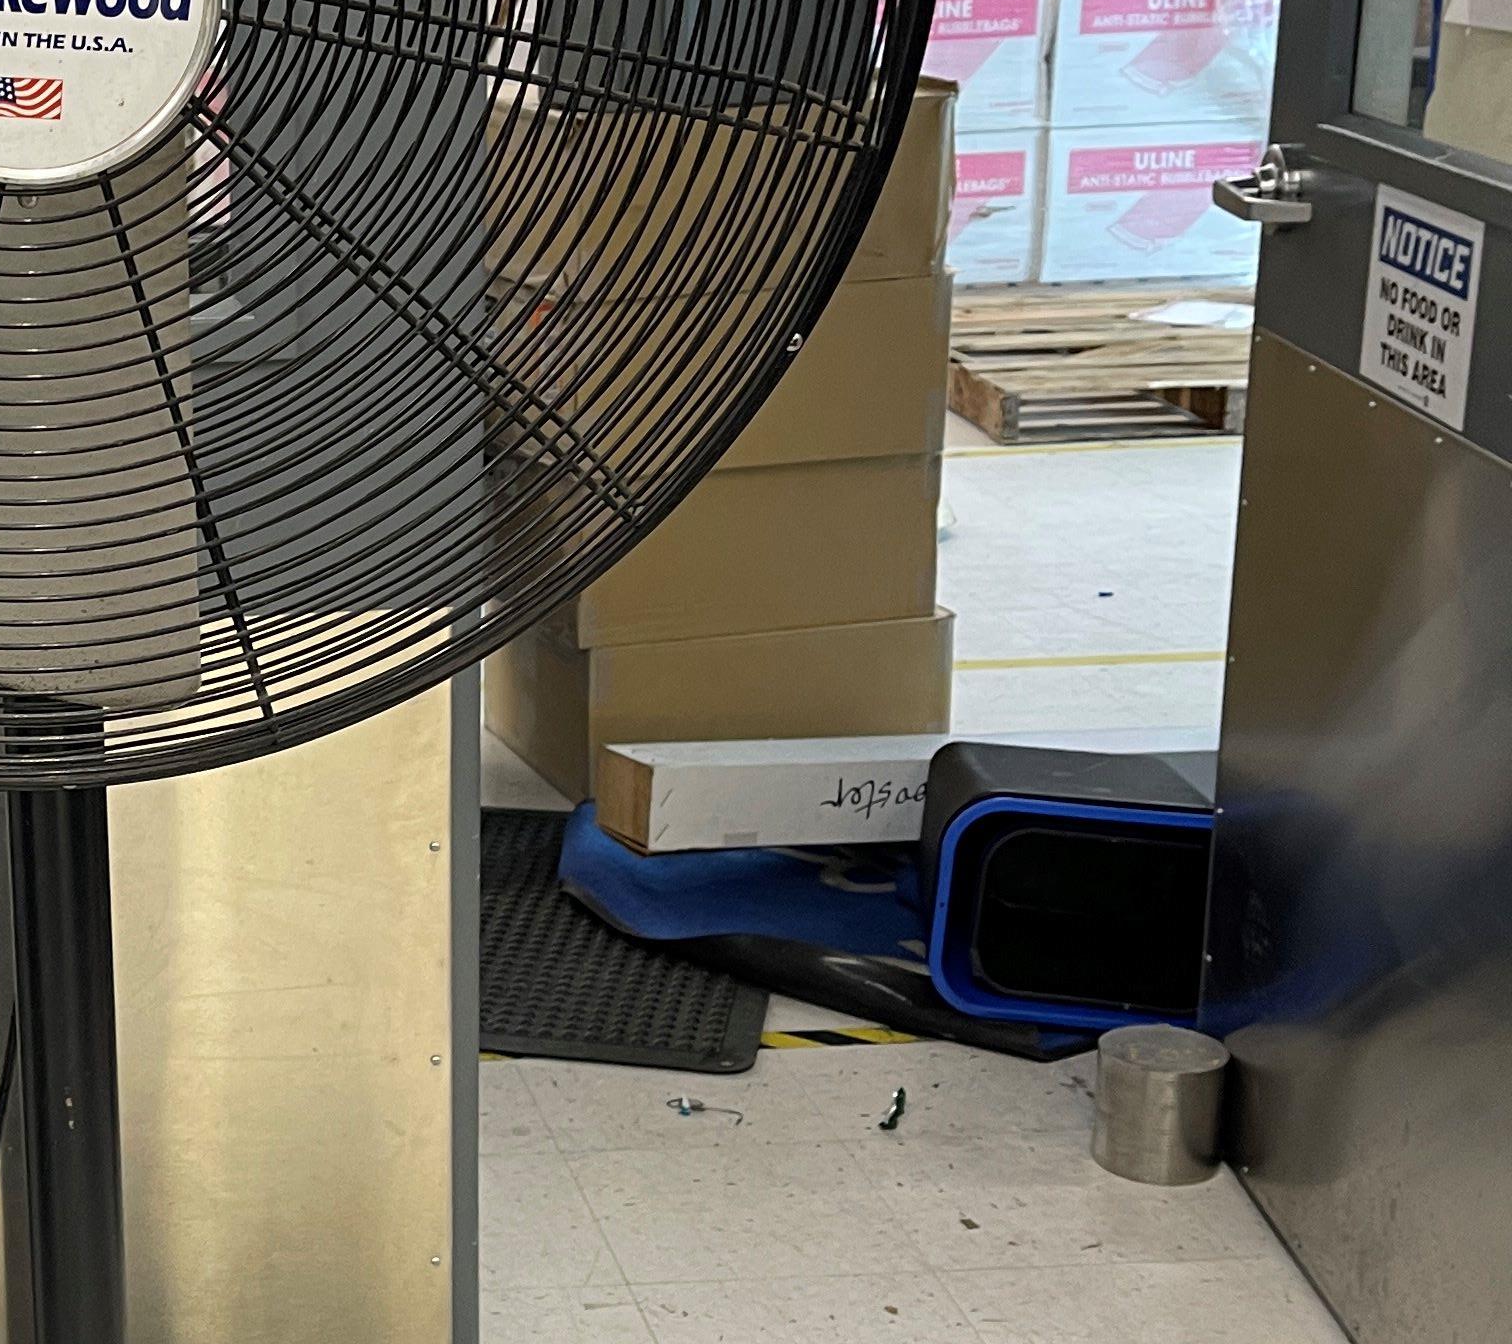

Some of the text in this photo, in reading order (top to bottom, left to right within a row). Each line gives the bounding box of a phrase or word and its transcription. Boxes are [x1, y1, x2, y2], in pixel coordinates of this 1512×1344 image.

[938, 0, 973, 17] INE
[23, 32, 66, 50] THE
[71, 34, 134, 53] U.S.A.
[1133, 150, 1196, 170] ULINE
[1381, 215, 1471, 290] NOTICE
[1380, 277, 1461, 337] NO FOOD OR
[1386, 313, 1446, 363] DRINK IN
[1380, 342, 1408, 377] THIS
[1411, 360, 1446, 399] AREA
